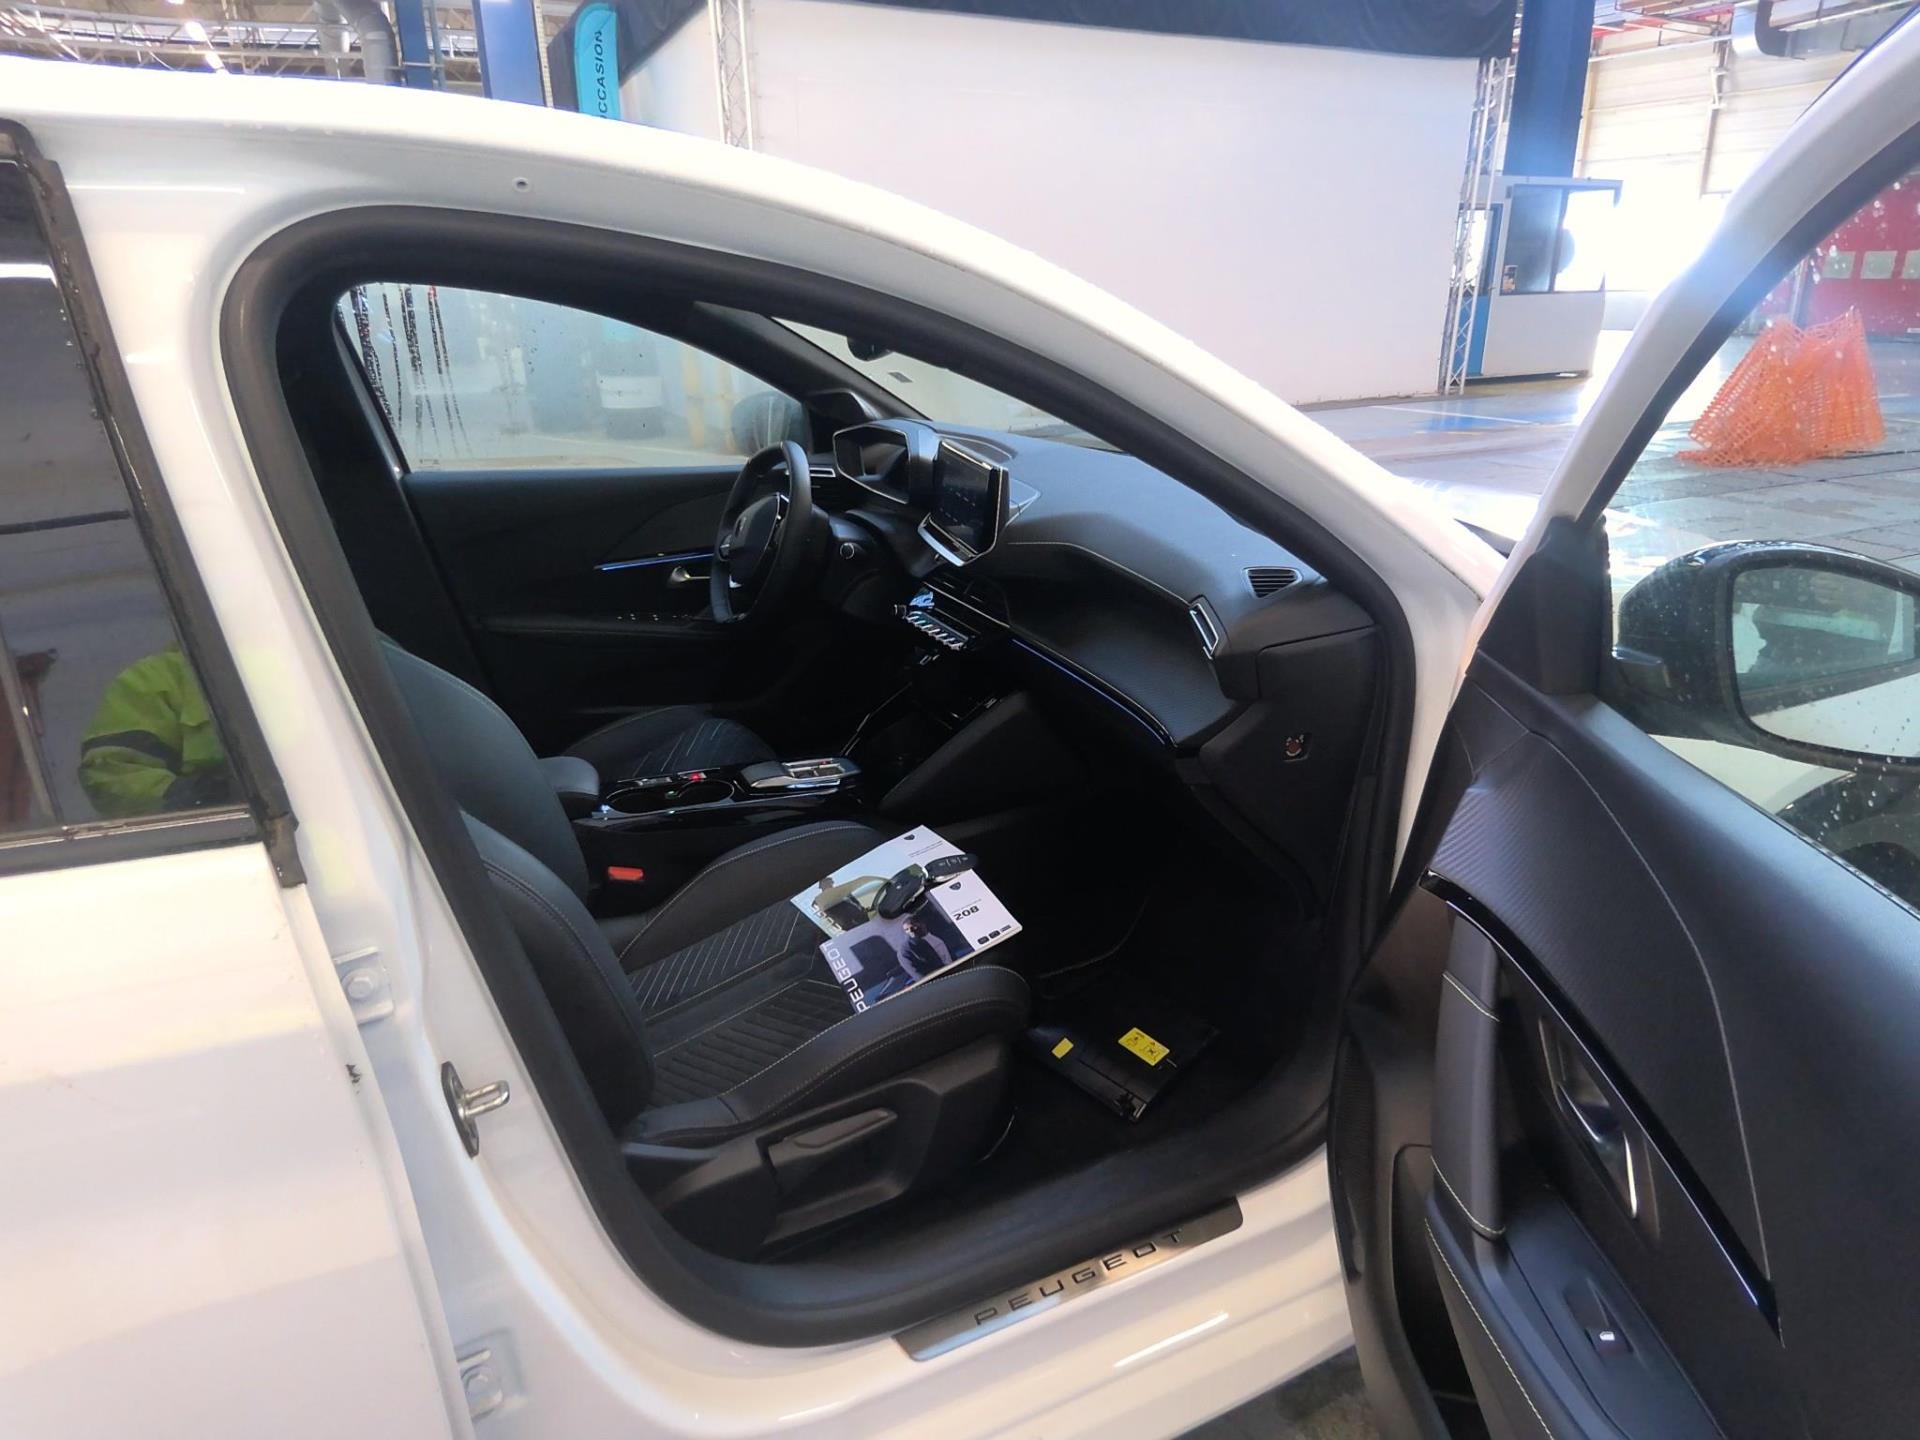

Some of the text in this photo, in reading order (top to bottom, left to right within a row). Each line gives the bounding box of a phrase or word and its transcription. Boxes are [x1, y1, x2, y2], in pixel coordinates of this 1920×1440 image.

[953, 905, 980, 921] 208
[819, 941, 870, 1013] PEUGEOT
[974, 1229, 1183, 1325] PEUGEOT
